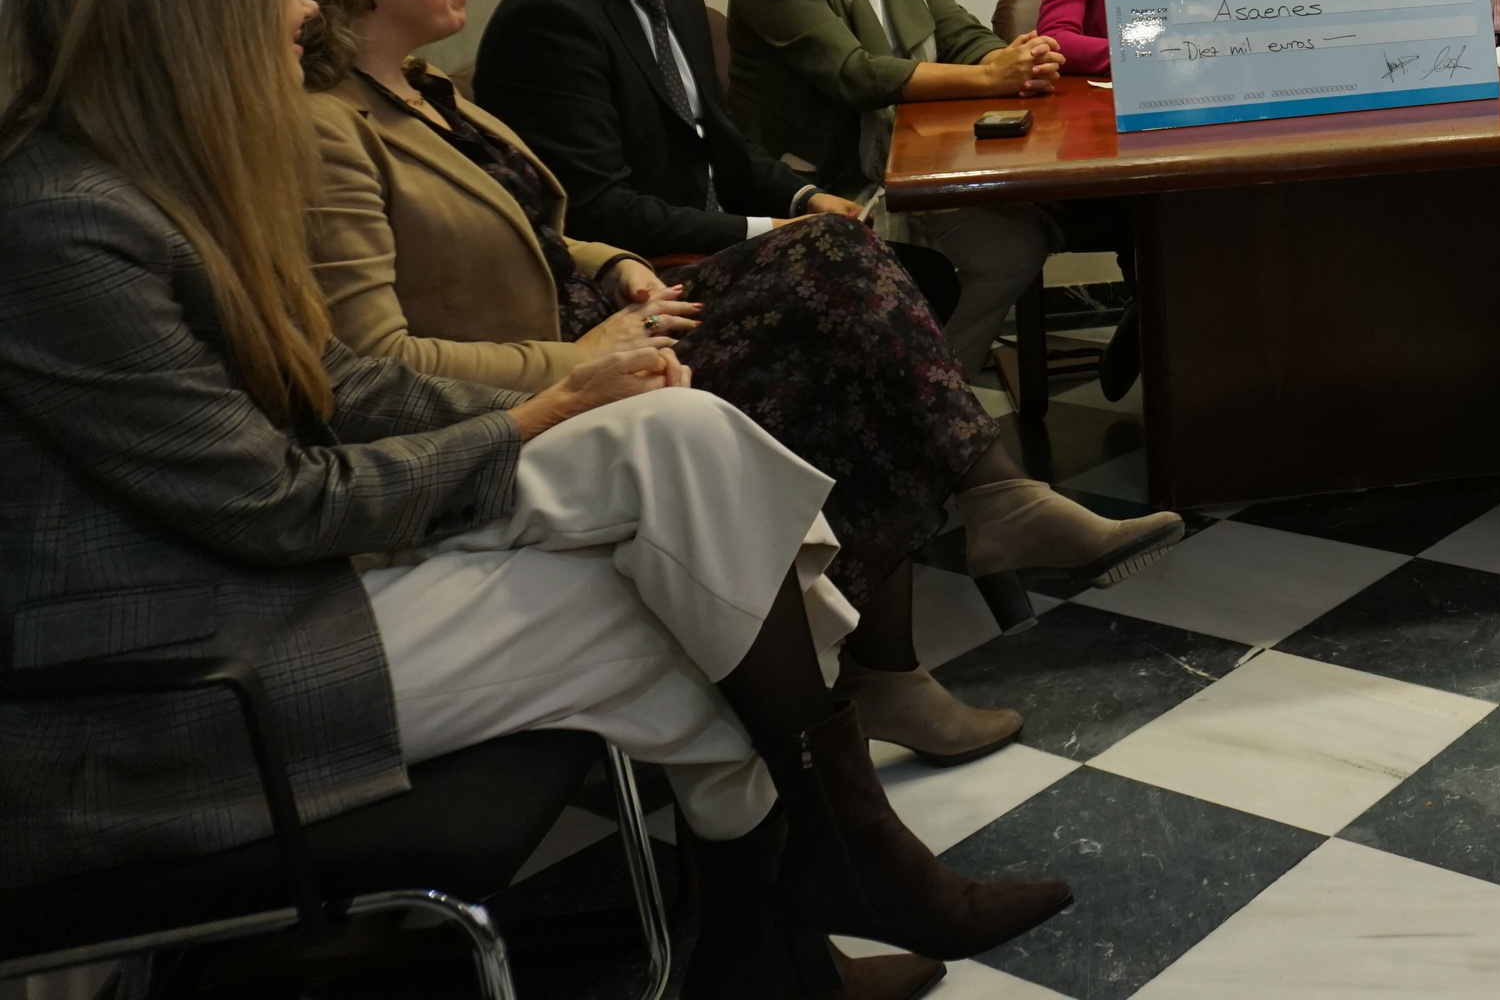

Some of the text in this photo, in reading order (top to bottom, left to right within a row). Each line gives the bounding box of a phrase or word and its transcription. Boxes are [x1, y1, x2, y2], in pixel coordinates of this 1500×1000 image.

[1213, 0, 1323, 22] Asaenes
[1182, 37, 1315, 61] Diez mil euros
